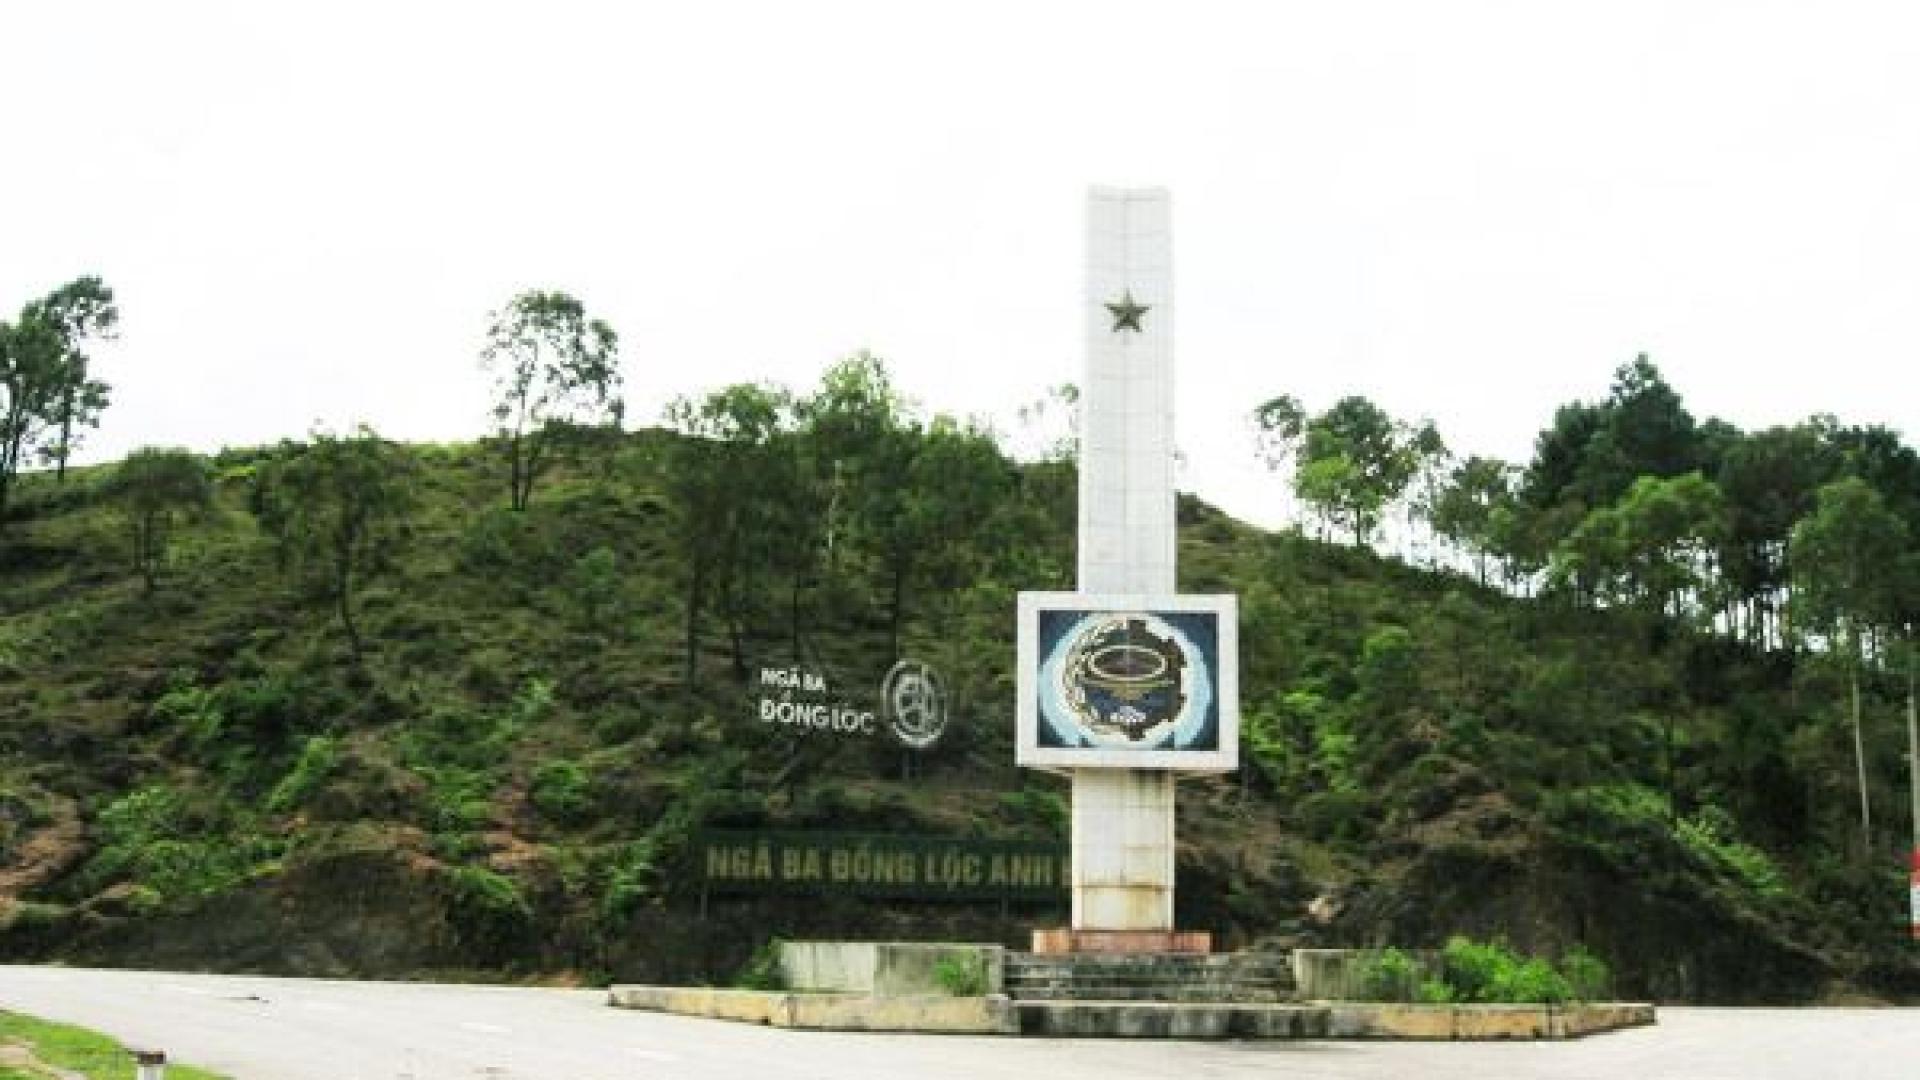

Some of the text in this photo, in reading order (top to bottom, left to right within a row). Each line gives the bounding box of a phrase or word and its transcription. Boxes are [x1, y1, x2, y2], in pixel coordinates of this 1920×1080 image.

[803, 674, 827, 693] BA
[707, 840, 772, 879] NGÃ
[784, 848, 820, 880] BA
[991, 852, 1053, 887] ANH
